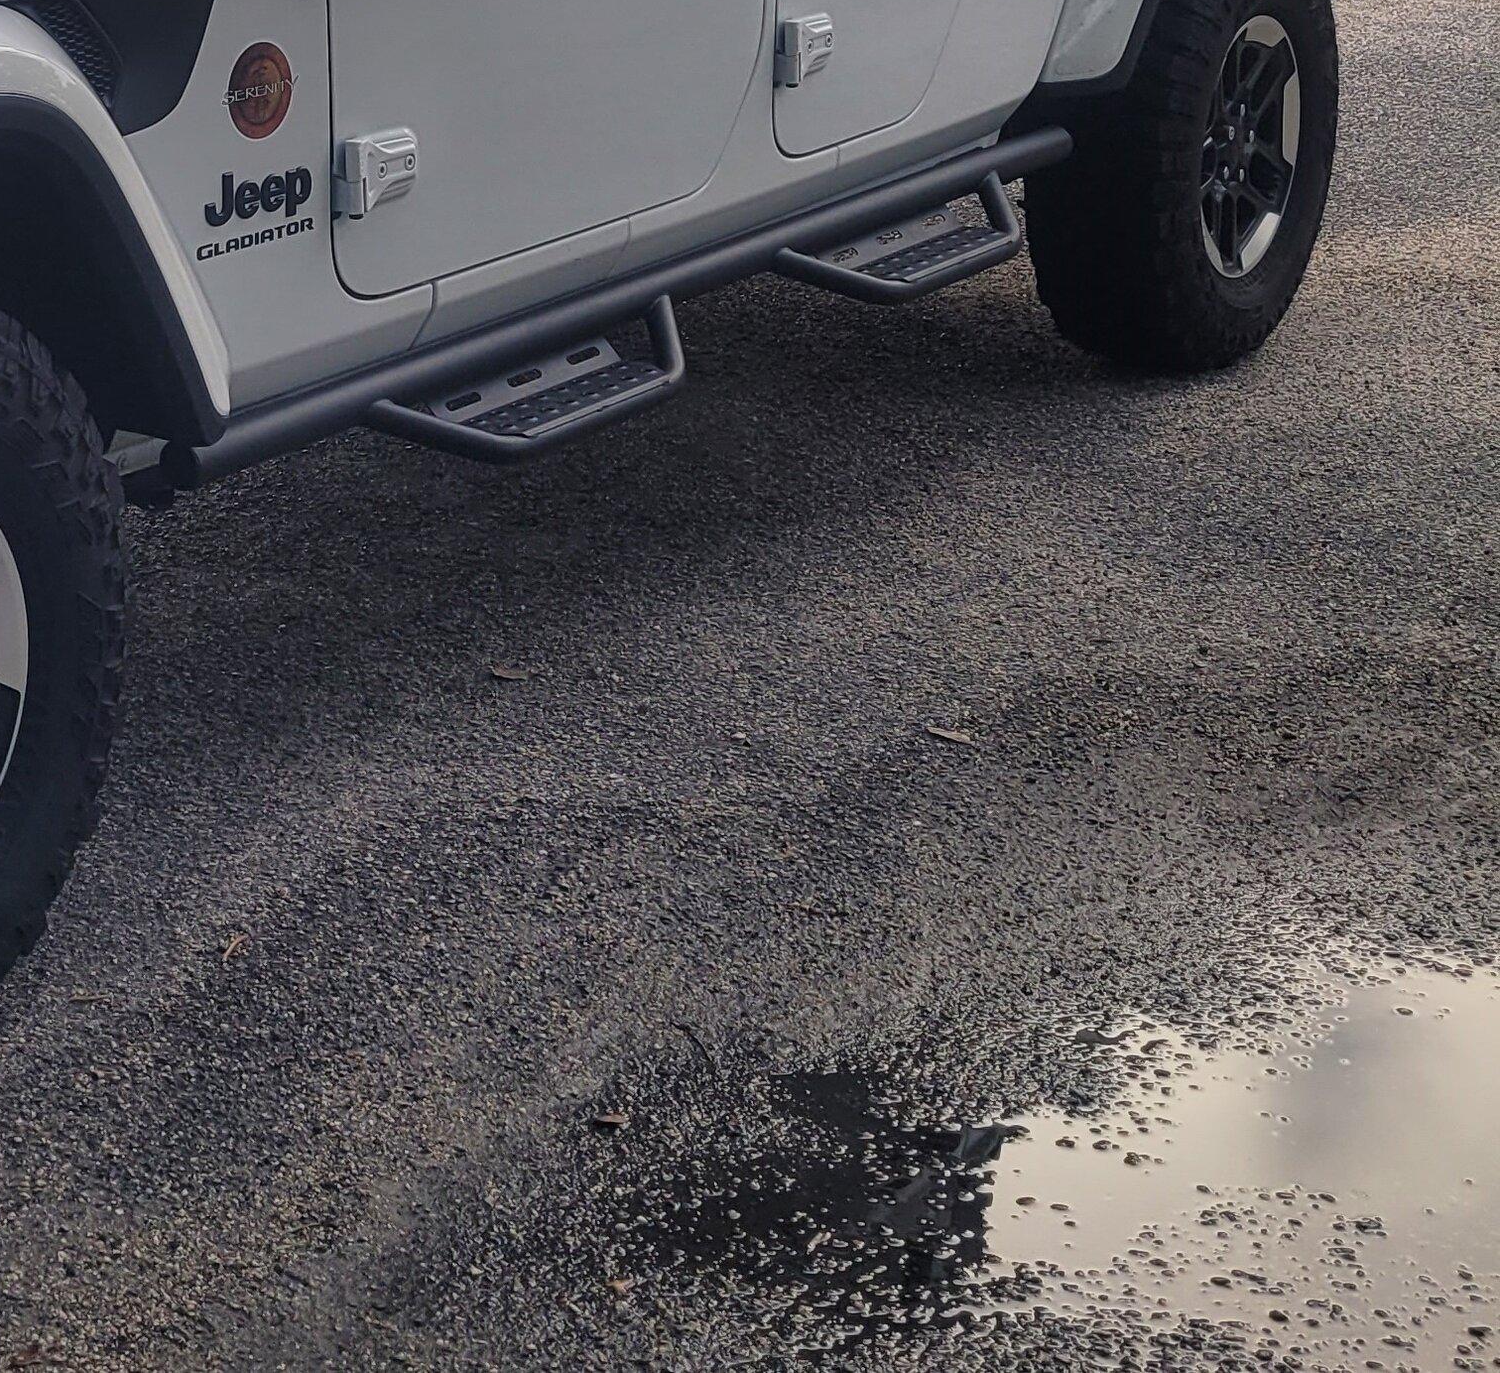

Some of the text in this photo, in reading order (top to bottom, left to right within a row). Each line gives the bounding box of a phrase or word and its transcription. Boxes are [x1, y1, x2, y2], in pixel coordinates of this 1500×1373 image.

[221, 75, 299, 105] SERENITY
[204, 167, 312, 226] Jeep
[197, 217, 314, 260] GLADIATOR
